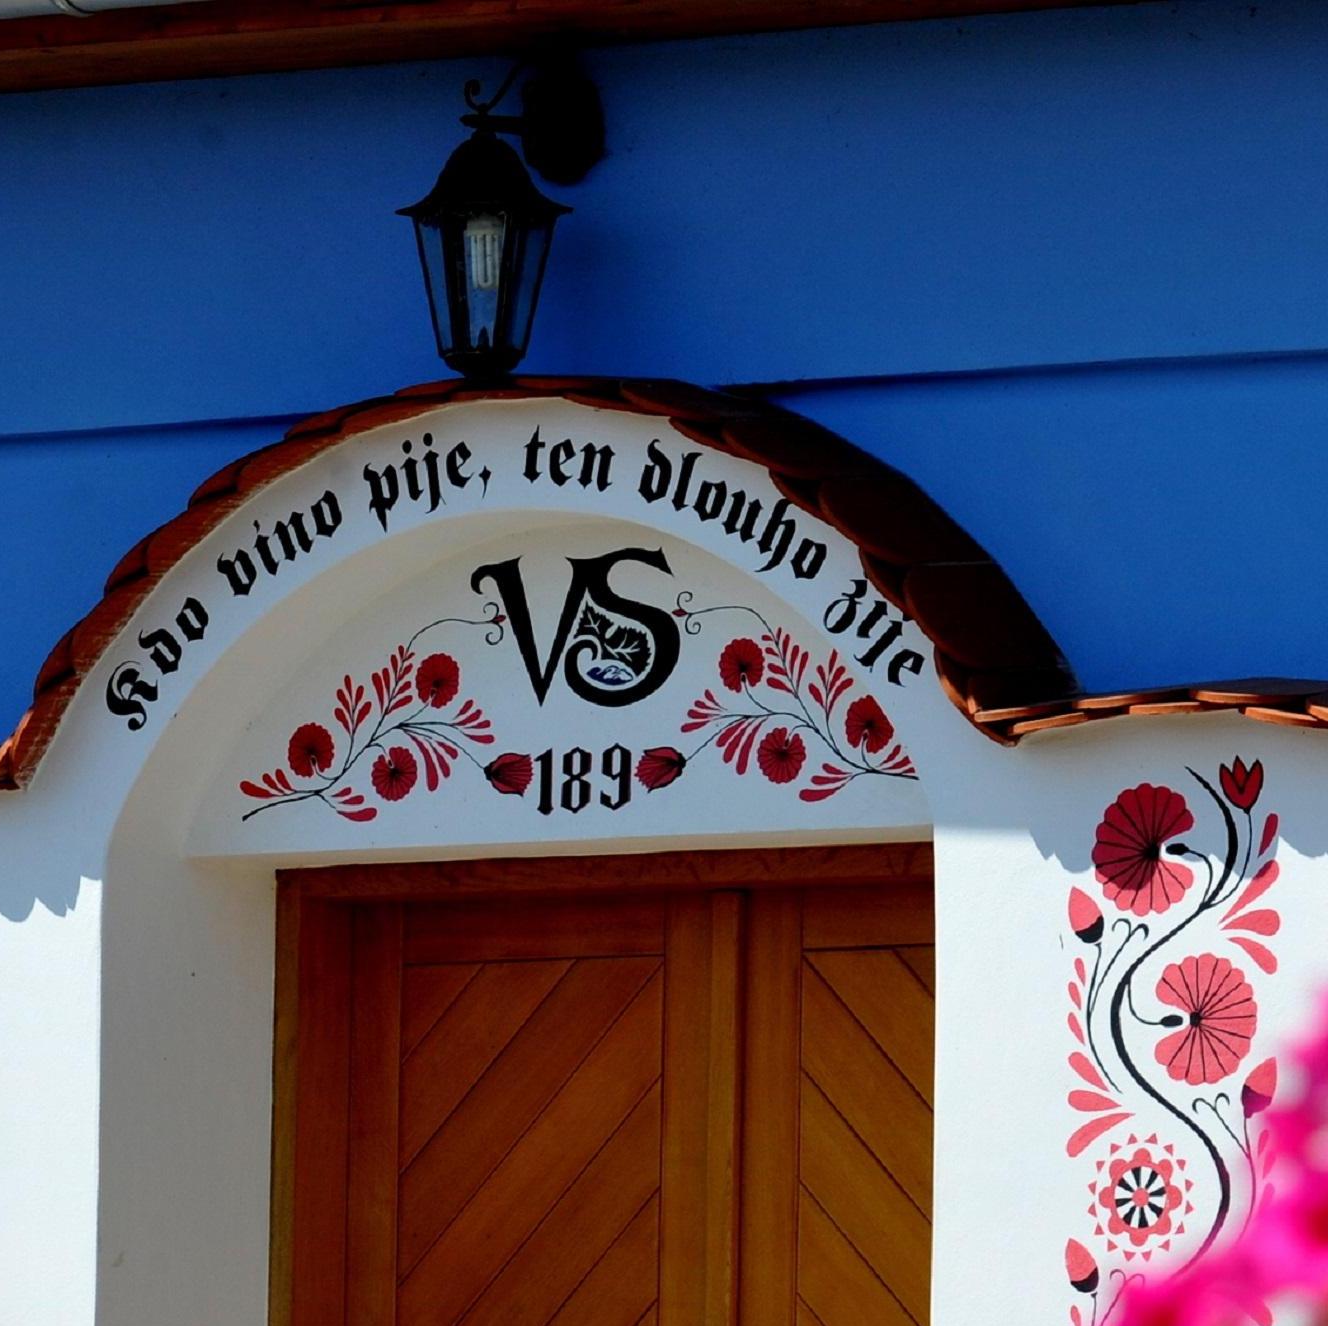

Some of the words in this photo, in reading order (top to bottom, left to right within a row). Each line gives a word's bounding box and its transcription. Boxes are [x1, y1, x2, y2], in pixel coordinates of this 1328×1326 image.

[105, 596, 209, 731] Kdo
[363, 432, 493, 533] pije,
[523, 424, 616, 492] ten
[638, 438, 828, 580] dlouho
[470, 546, 681, 708] VS
[534, 742, 632, 816] 189
